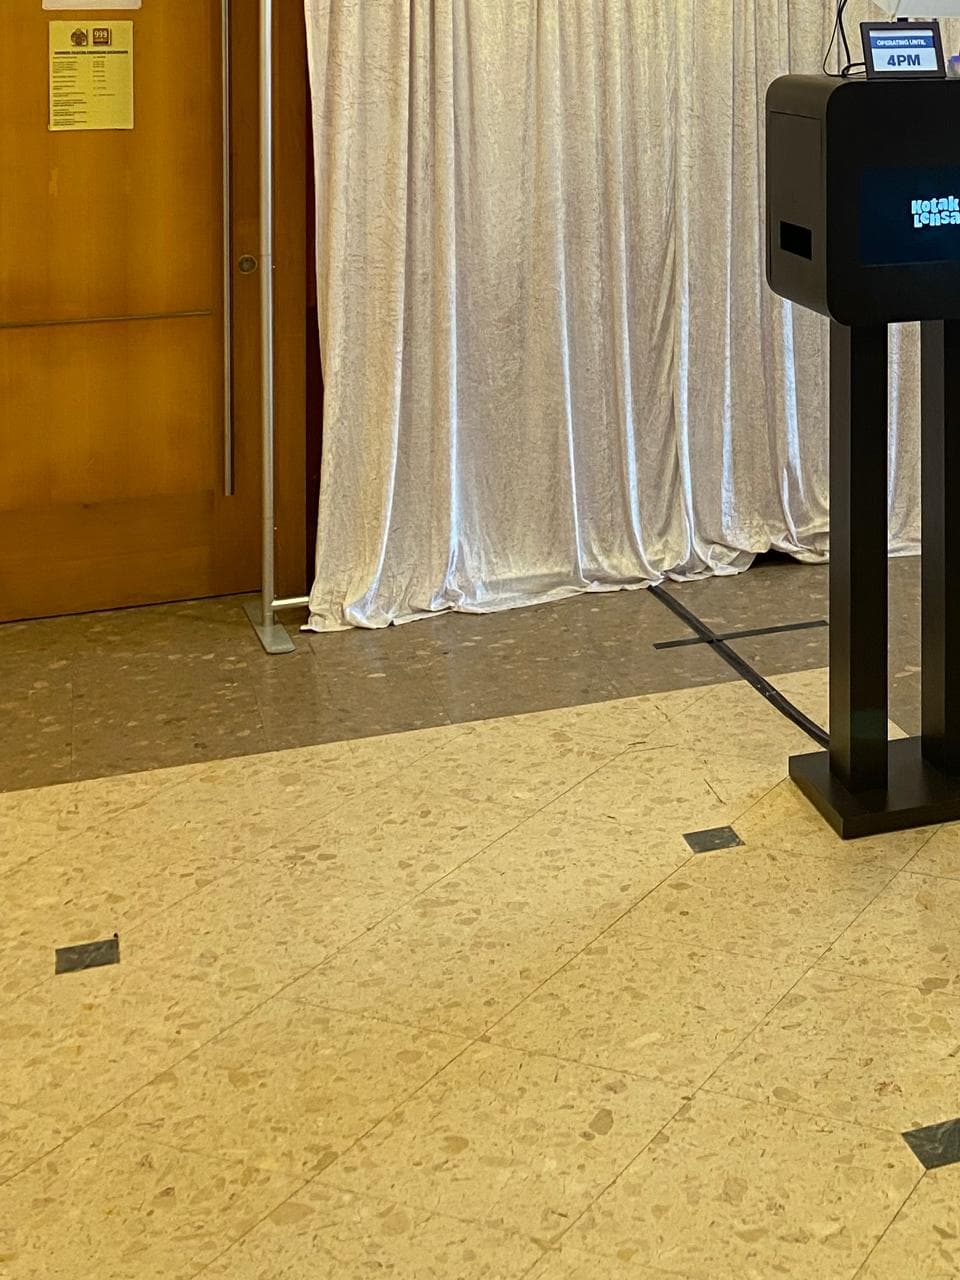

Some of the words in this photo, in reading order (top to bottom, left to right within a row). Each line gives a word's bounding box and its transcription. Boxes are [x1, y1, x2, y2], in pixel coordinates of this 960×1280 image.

[887, 54, 921, 66] 4PM
[911, 195, 960, 214] Kotak
[913, 211, 960, 228] Lensa
